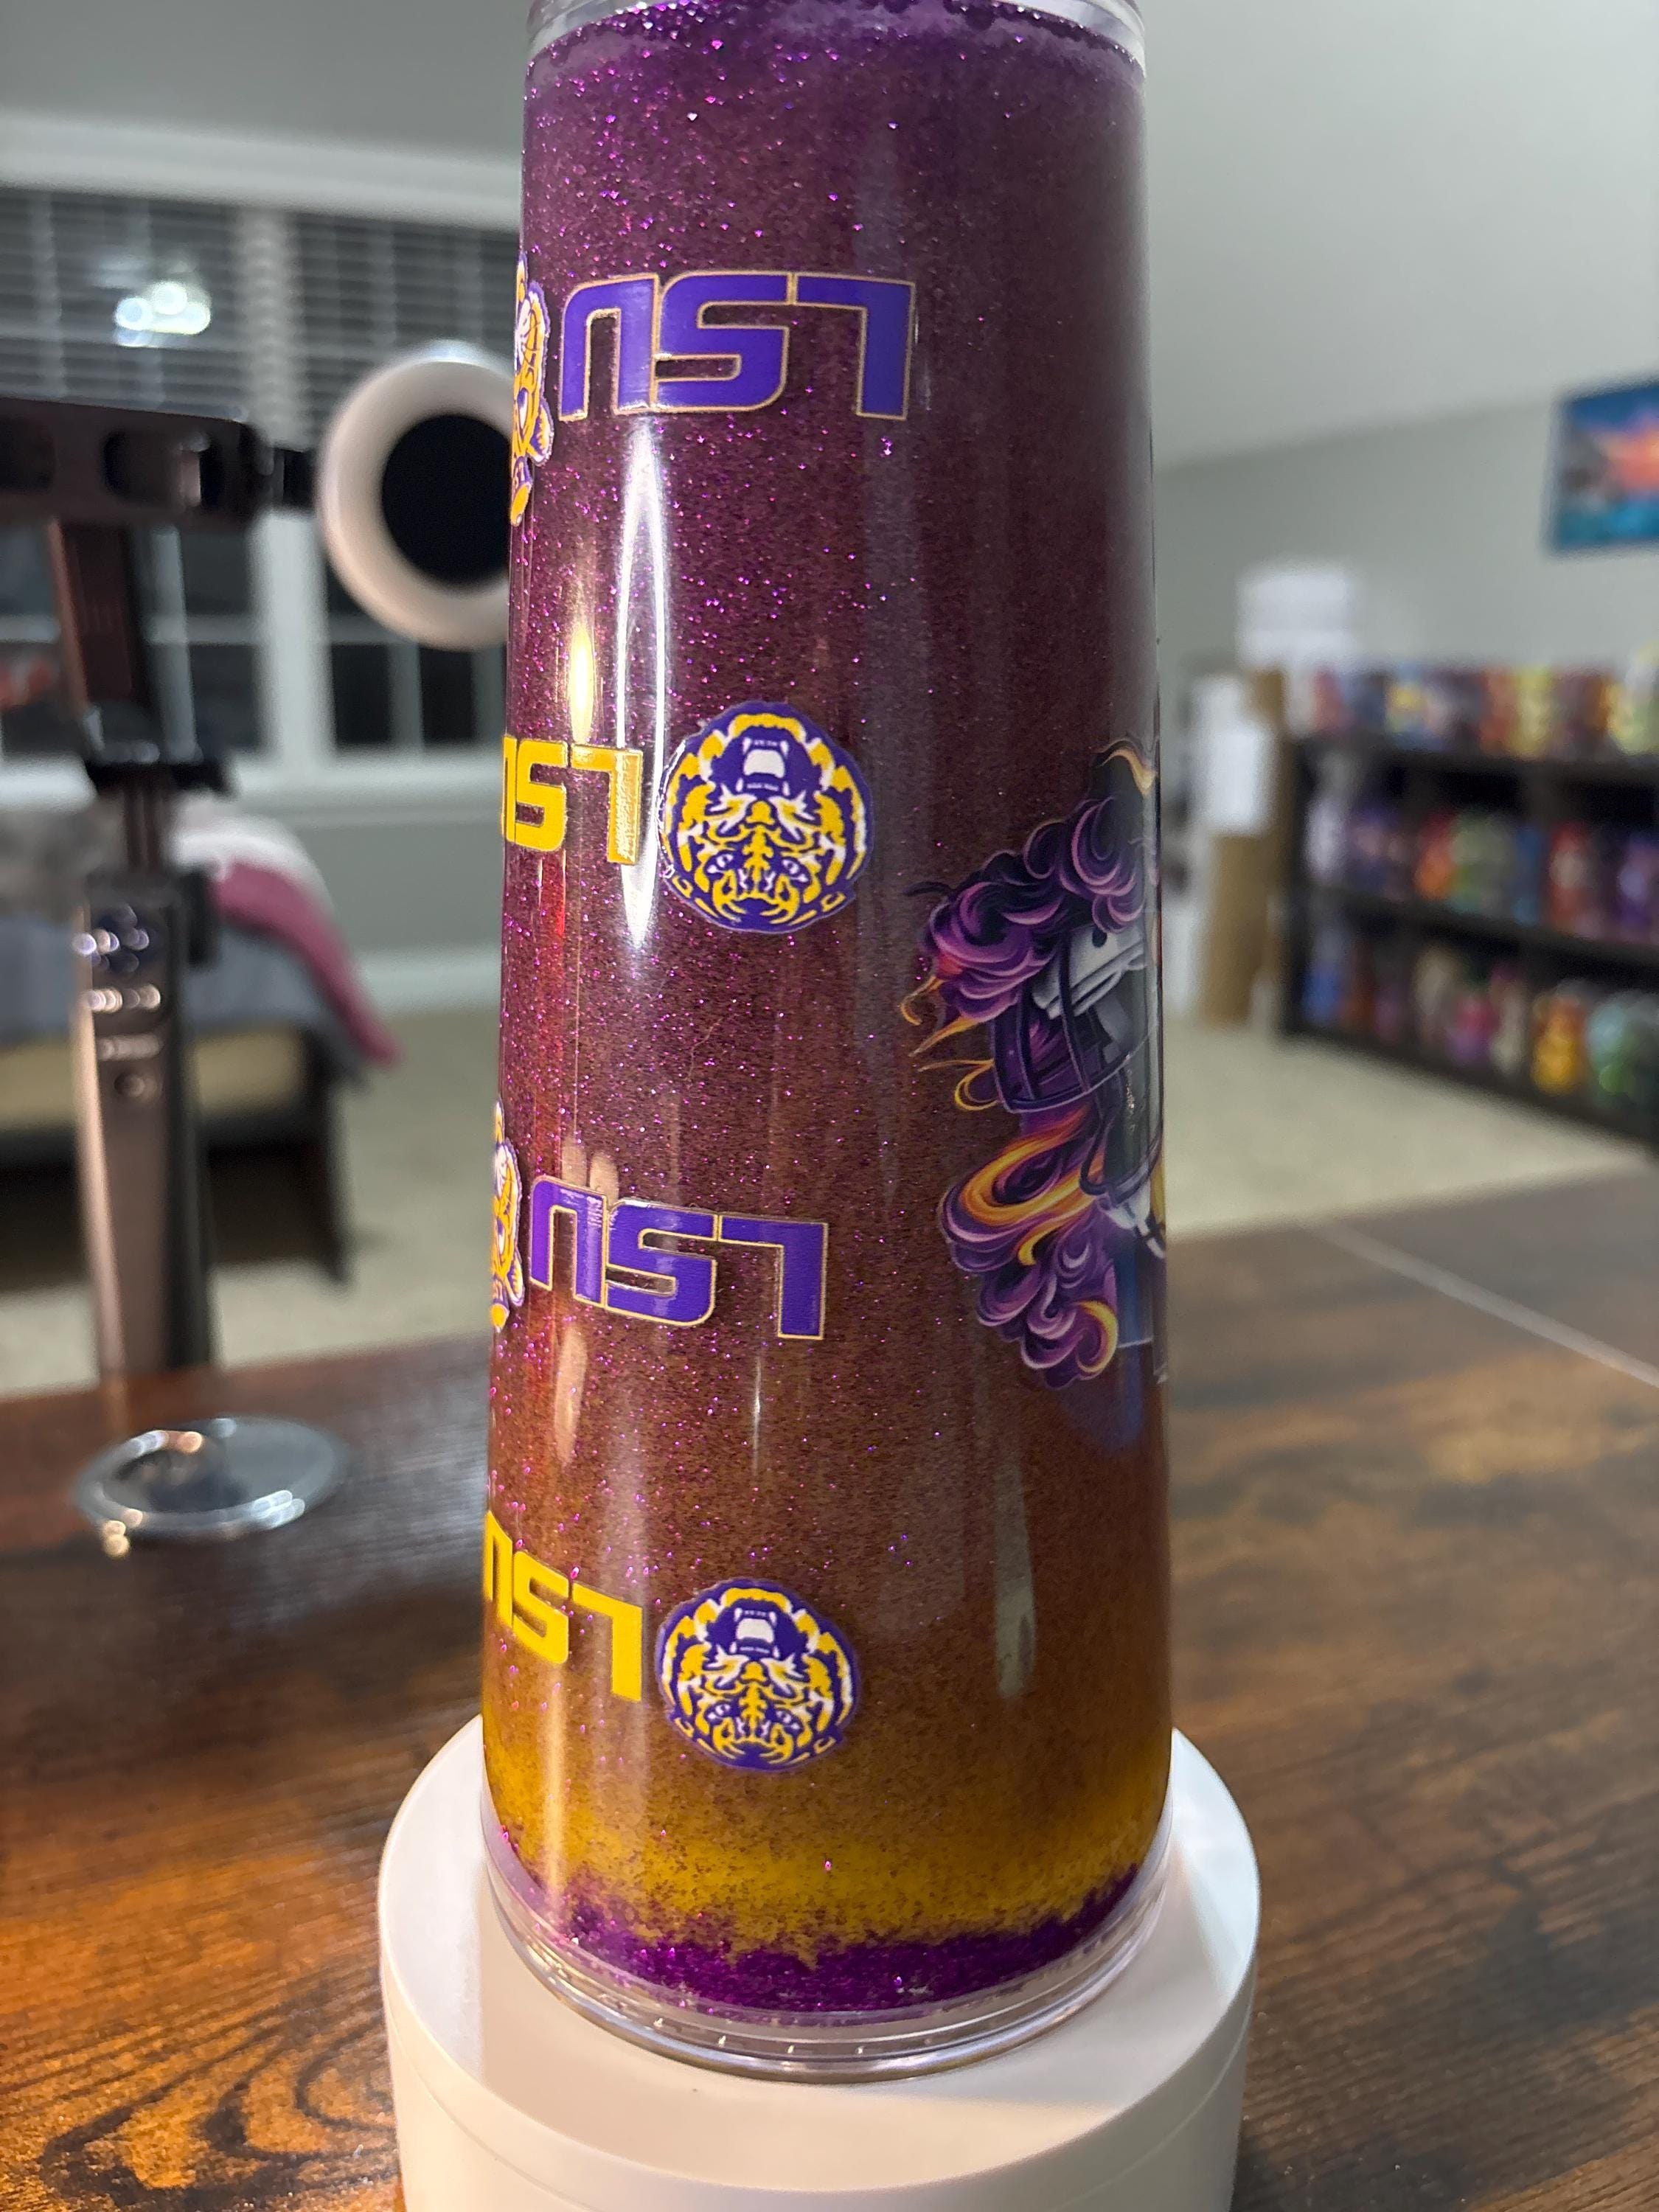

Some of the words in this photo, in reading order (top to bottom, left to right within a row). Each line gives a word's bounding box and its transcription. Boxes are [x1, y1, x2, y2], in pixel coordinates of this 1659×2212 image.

[557, 268, 917, 421] LSU
[530, 1175, 829, 1340] LSU
[484, 1510, 643, 1702] LSU
